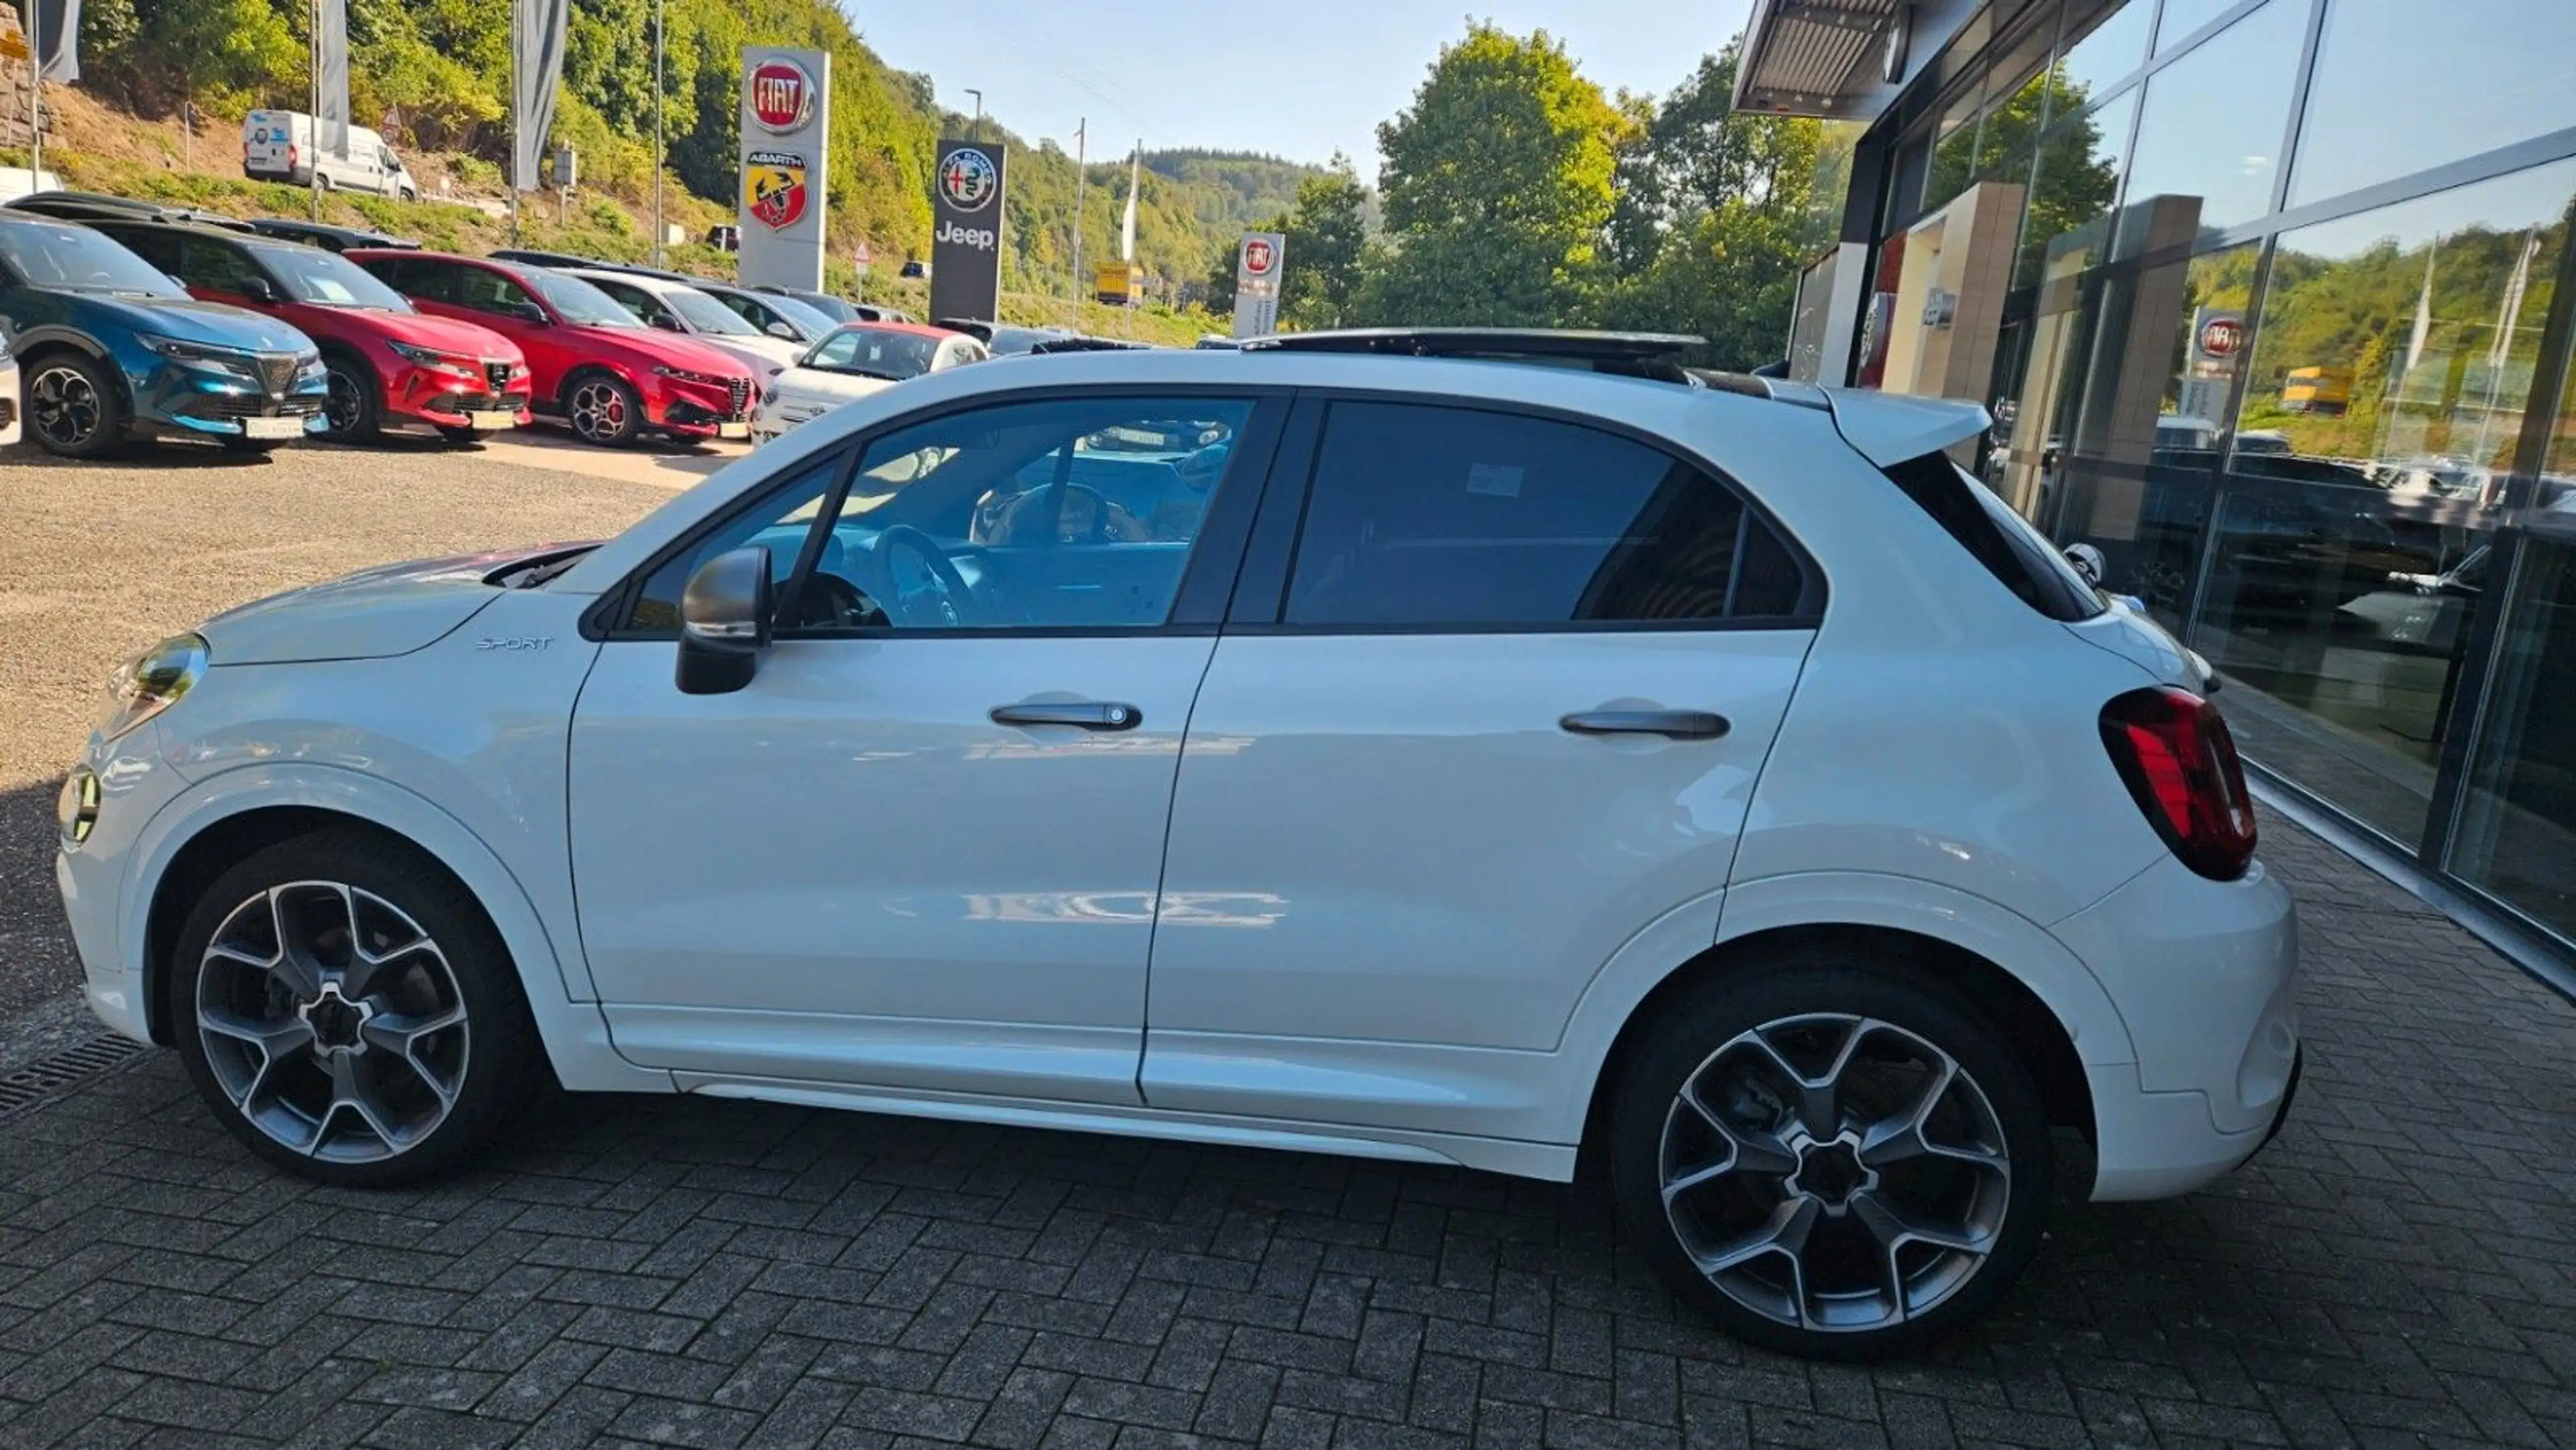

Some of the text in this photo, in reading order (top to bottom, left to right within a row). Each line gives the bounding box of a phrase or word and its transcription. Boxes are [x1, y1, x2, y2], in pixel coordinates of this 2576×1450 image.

[758, 77, 798, 113] FIAT
[750, 154, 802, 166] ABARTH
[936, 220, 994, 251] Jeep
[476, 637, 553, 650] SPORT
